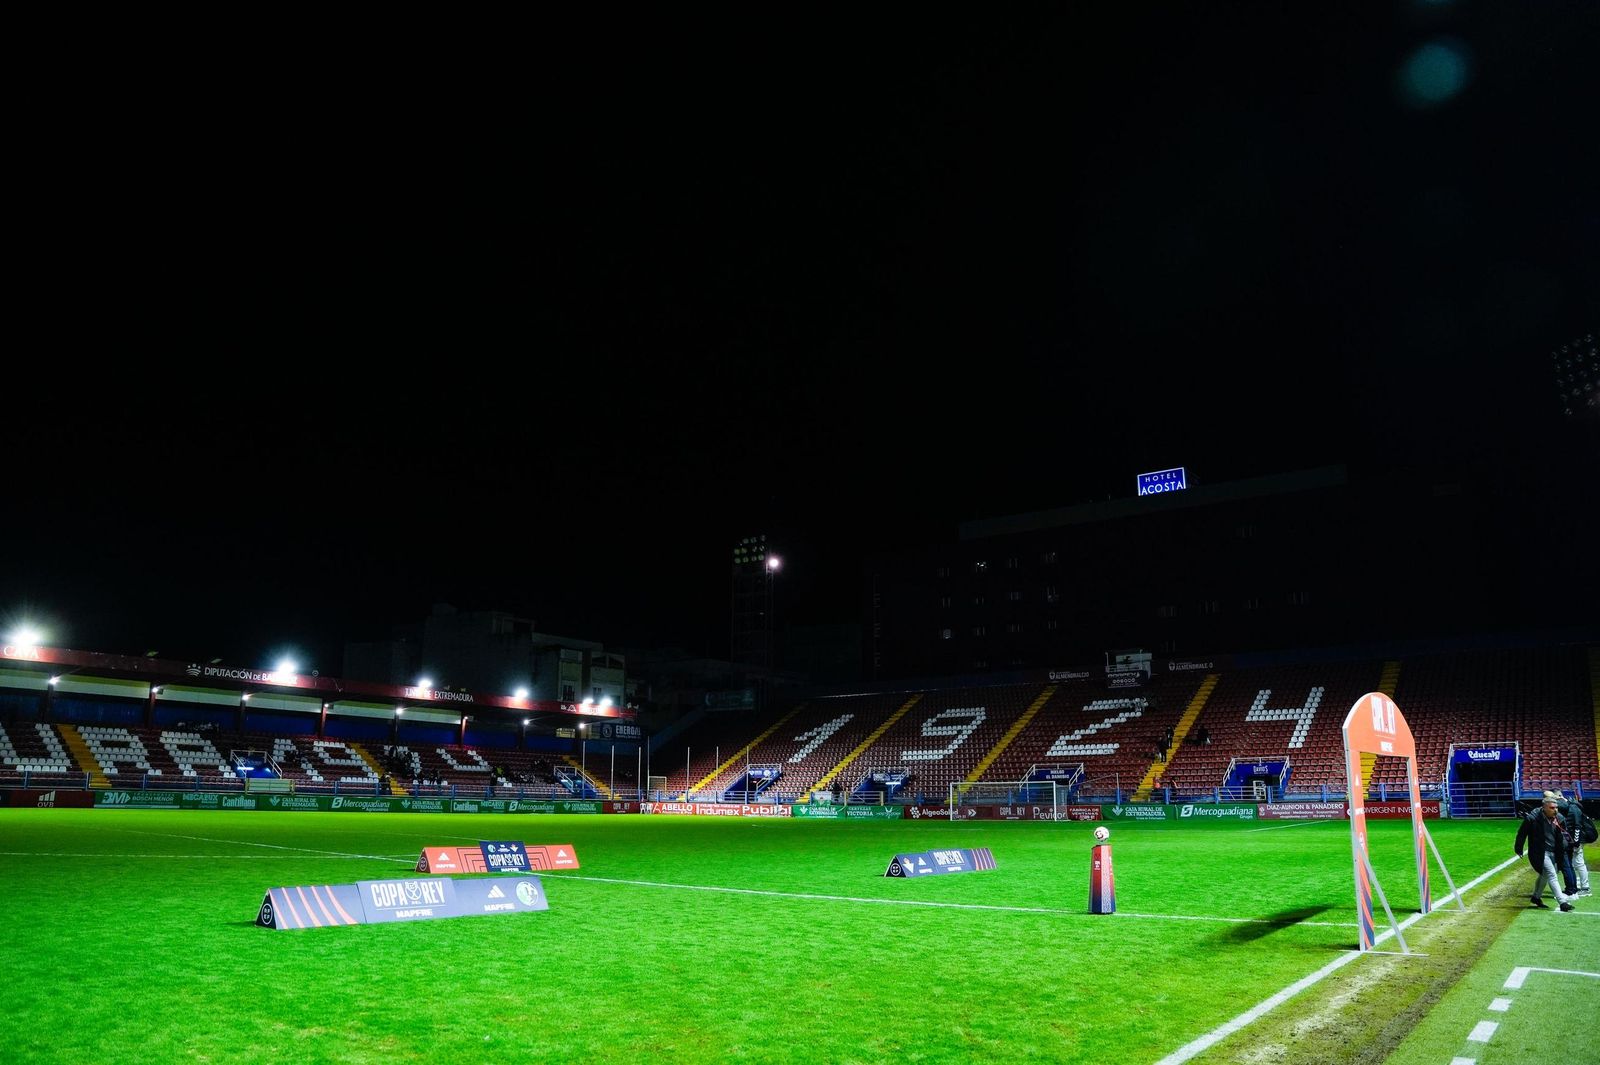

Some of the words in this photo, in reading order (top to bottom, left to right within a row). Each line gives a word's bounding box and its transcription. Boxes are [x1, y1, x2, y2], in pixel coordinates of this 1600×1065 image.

[1145, 473, 1177, 482] HOTEL
[1141, 481, 1184, 495] ACOSTA
[204, 666, 252, 680] DIPUTACIÓN
[434, 691, 474, 703] EXTREMADURA
[342, 799, 390, 810] Mercoguadiana
[517, 803, 555, 813] Mercoguadiana
[661, 803, 693, 812] ABELLO
[696, 803, 741, 815] Indumex
[999, 806, 1012, 816] COPA
[1193, 806, 1254, 817] Mercoguadiana
[488, 854, 507, 866] COPA
[512, 854, 525, 865] REY
[370, 883, 408, 907] COPA
[422, 881, 446, 904] REY
[484, 902, 516, 911] MAPFRE
[395, 908, 433, 918] MAPFRE
